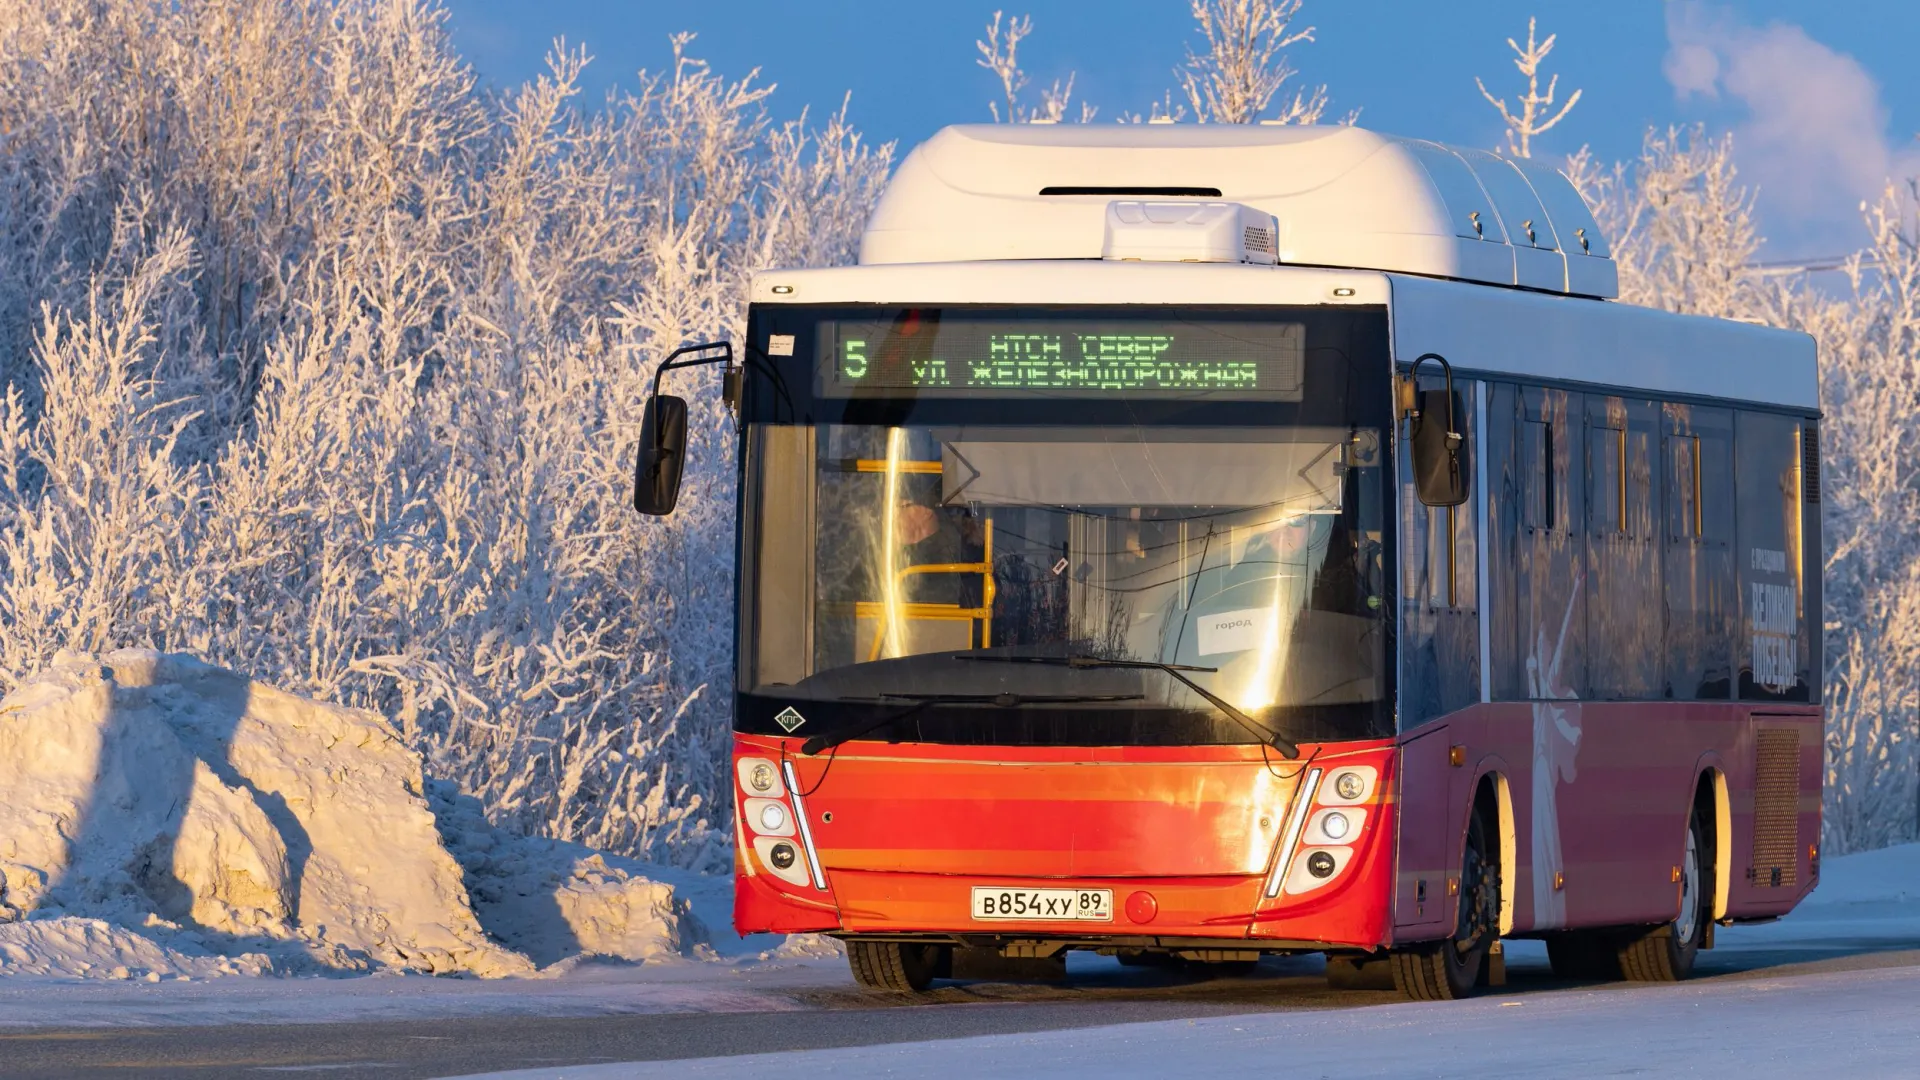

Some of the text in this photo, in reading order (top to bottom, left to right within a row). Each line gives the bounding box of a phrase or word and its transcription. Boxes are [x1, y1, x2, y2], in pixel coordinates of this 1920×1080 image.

[845, 340, 867, 378] 5
[967, 360, 1257, 390] ЖЕЛЕЗНОДОРОЖНАЯ
[1752, 578, 1797, 636] ВЕЛИКОЙ
[1215, 619, 1253, 630] город
[781, 715, 799, 724] КПГ
[983, 892, 1102, 915] В854ХУ 89
[1078, 909, 1095, 917] RUS
